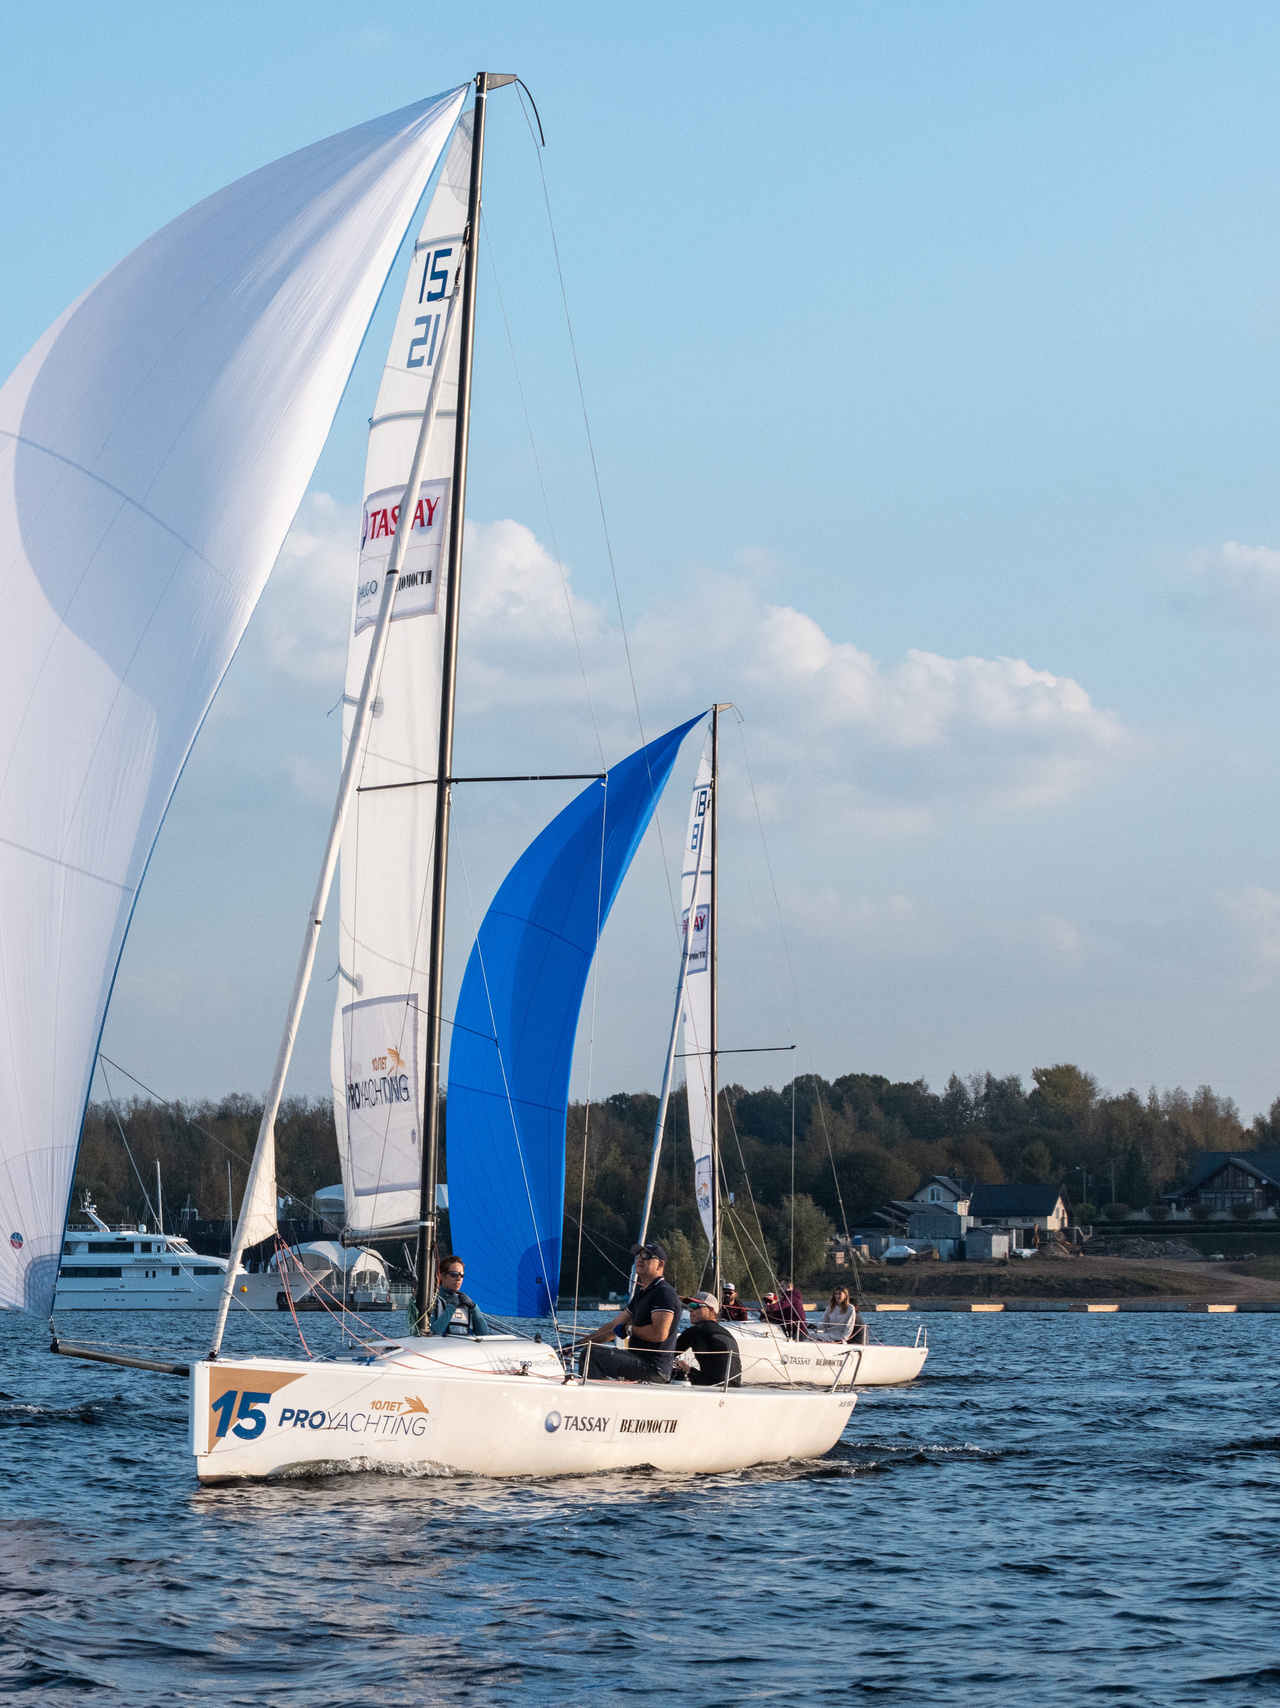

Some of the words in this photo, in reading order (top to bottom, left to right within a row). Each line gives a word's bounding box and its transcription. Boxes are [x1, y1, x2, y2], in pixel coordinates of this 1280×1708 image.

[418, 247, 453, 304] 15
[369, 496, 441, 540] TASAY
[789, 1356, 811, 1366] TASSAY
[211, 1389, 273, 1441] 15
[277, 1407, 429, 1437] PROYACHTING
[563, 1415, 611, 1432] TASSAY
[619, 1418, 679, 1434] ВЕДОМОСТИ
